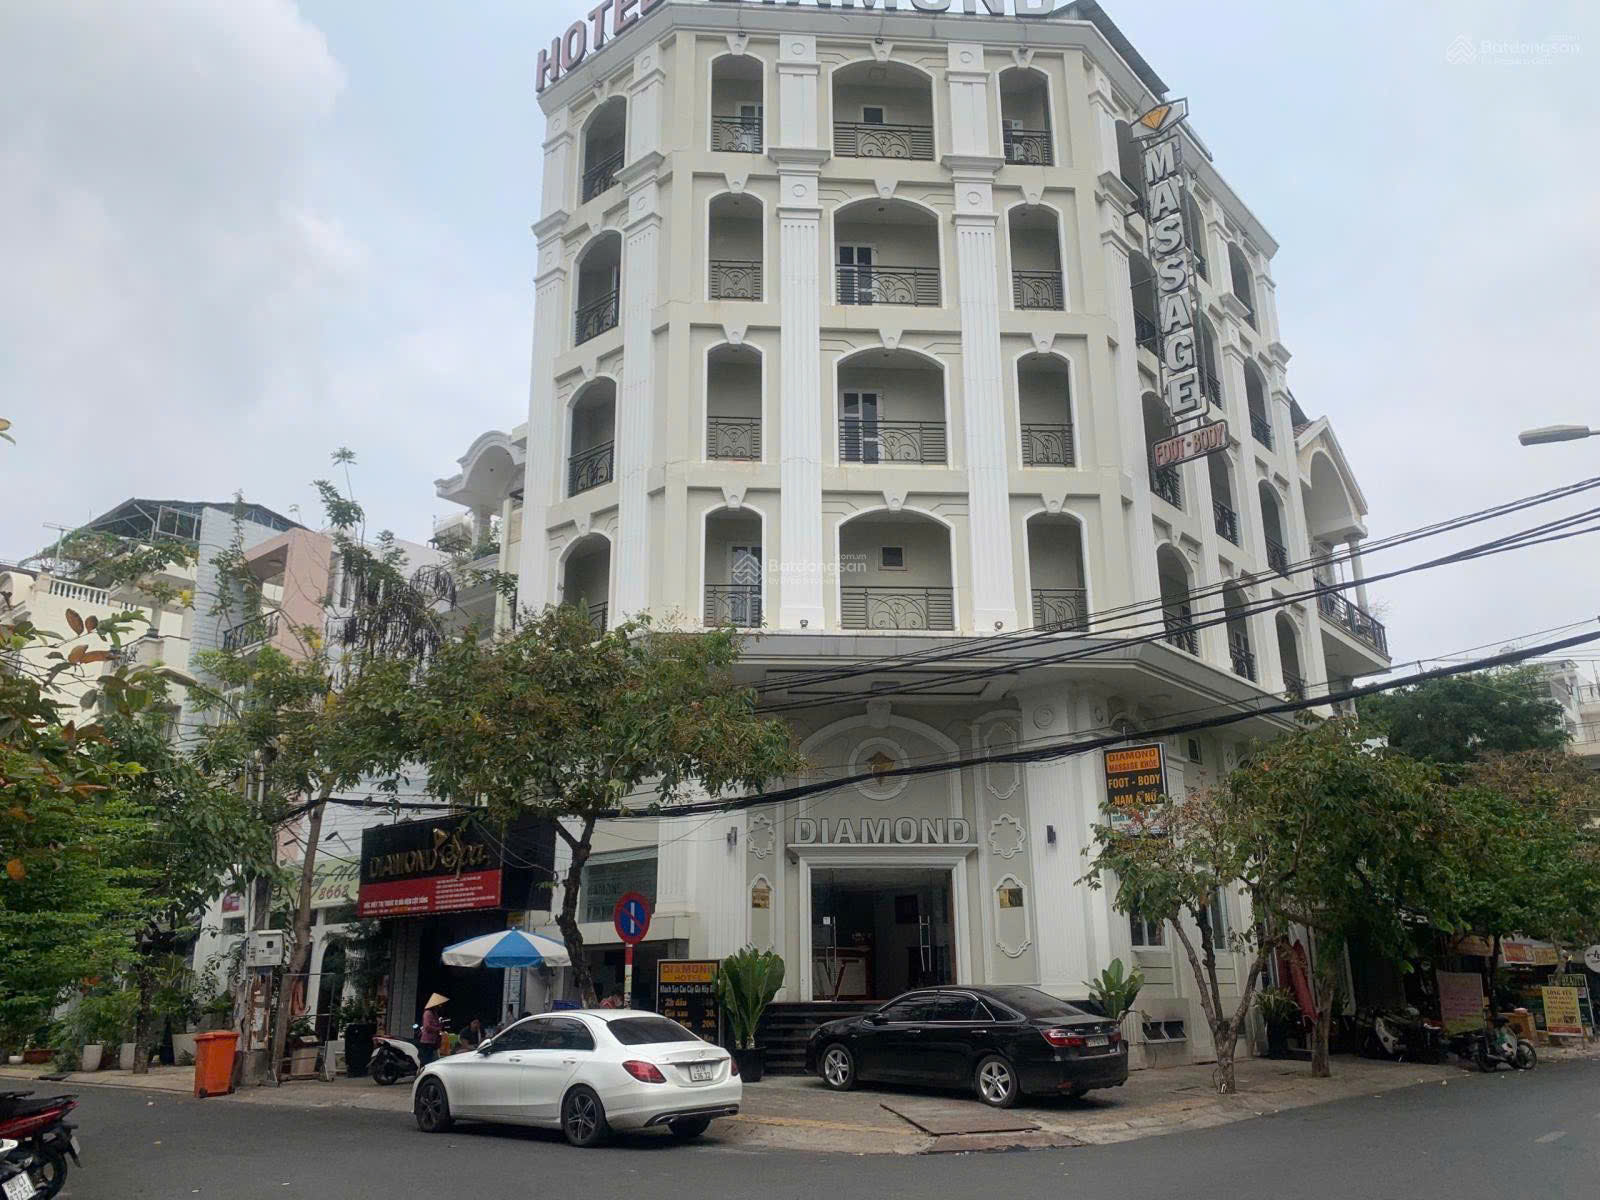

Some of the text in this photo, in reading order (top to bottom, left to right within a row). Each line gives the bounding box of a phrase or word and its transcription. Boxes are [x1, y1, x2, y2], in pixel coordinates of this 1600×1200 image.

[1145, 149, 1201, 415] MASSAGE
[1155, 423, 1225, 466] FOOT BODY
[1108, 749, 1156, 762] DIAMOND
[1108, 777, 1129, 789] FOOT
[1138, 774, 1161, 786] BODY
[1114, 793, 1134, 805] NAM
[793, 816, 970, 845] DIAMOND
[369, 848, 438, 878] DIAMOND
